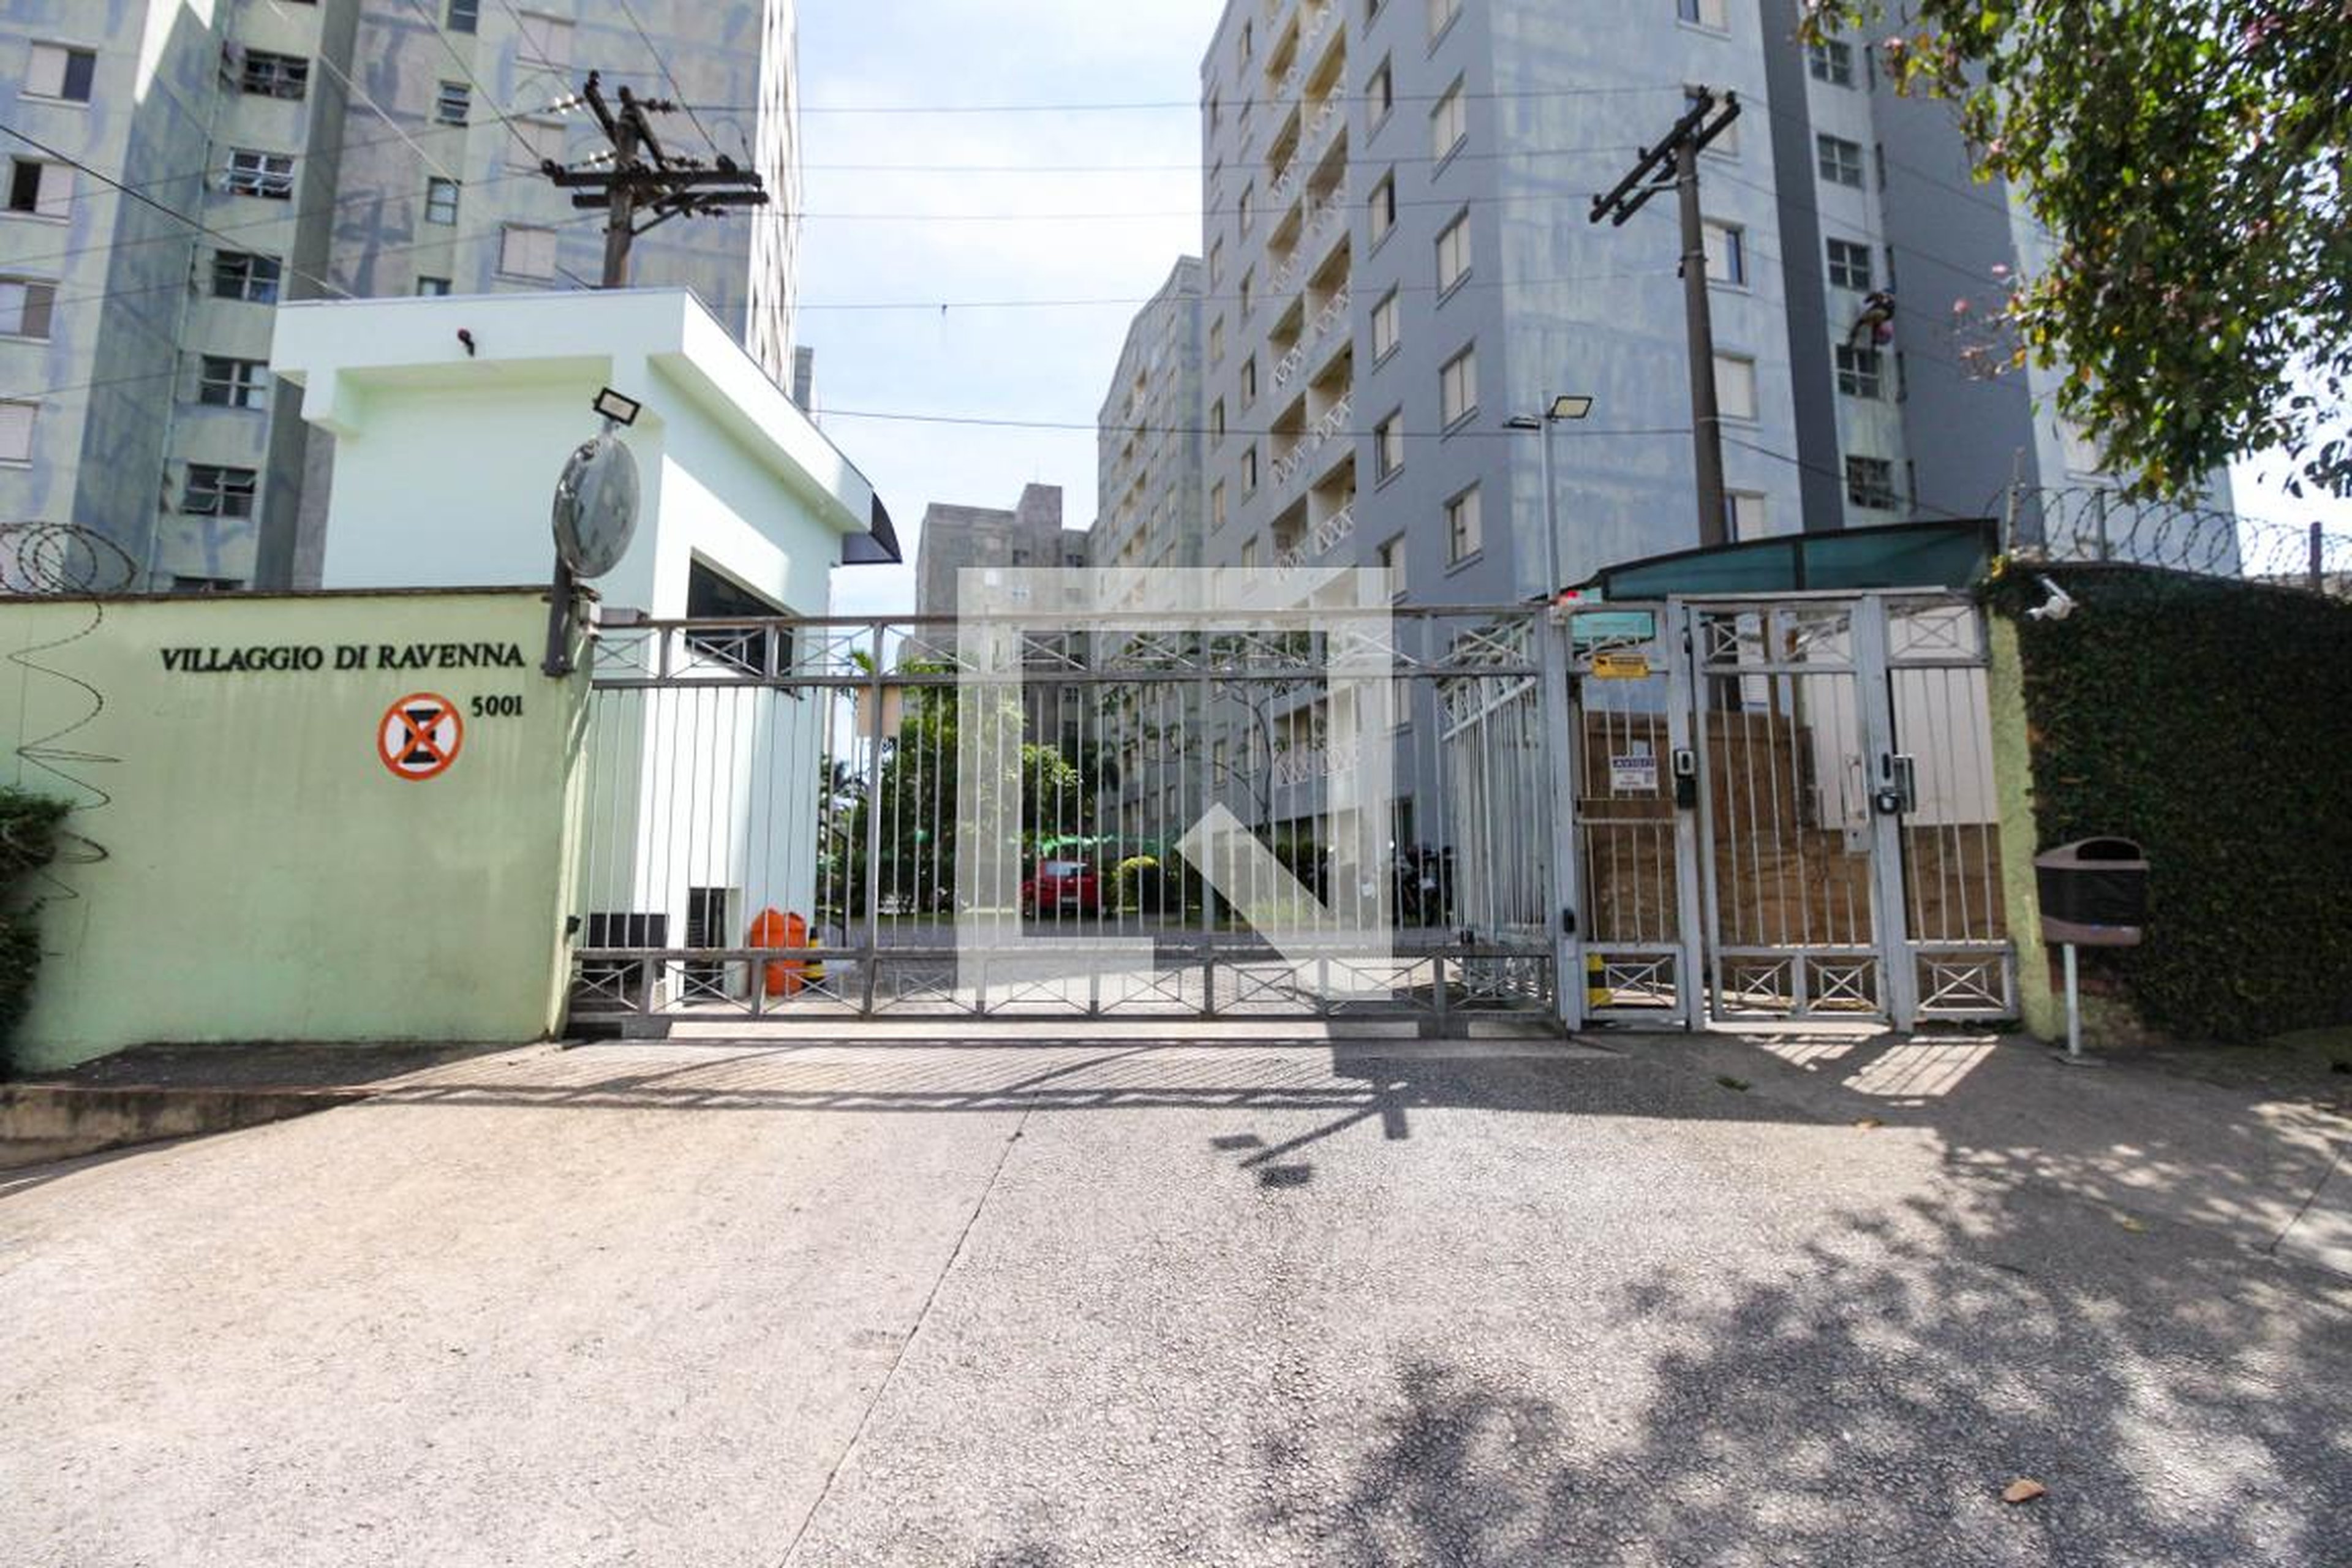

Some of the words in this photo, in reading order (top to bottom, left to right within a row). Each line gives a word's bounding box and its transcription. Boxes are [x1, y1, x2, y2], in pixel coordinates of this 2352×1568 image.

[160, 646, 324, 673] VILLAGGIO
[334, 645, 369, 670] DI
[376, 643, 526, 669] RAVENNA
[471, 695, 523, 717] 5001
